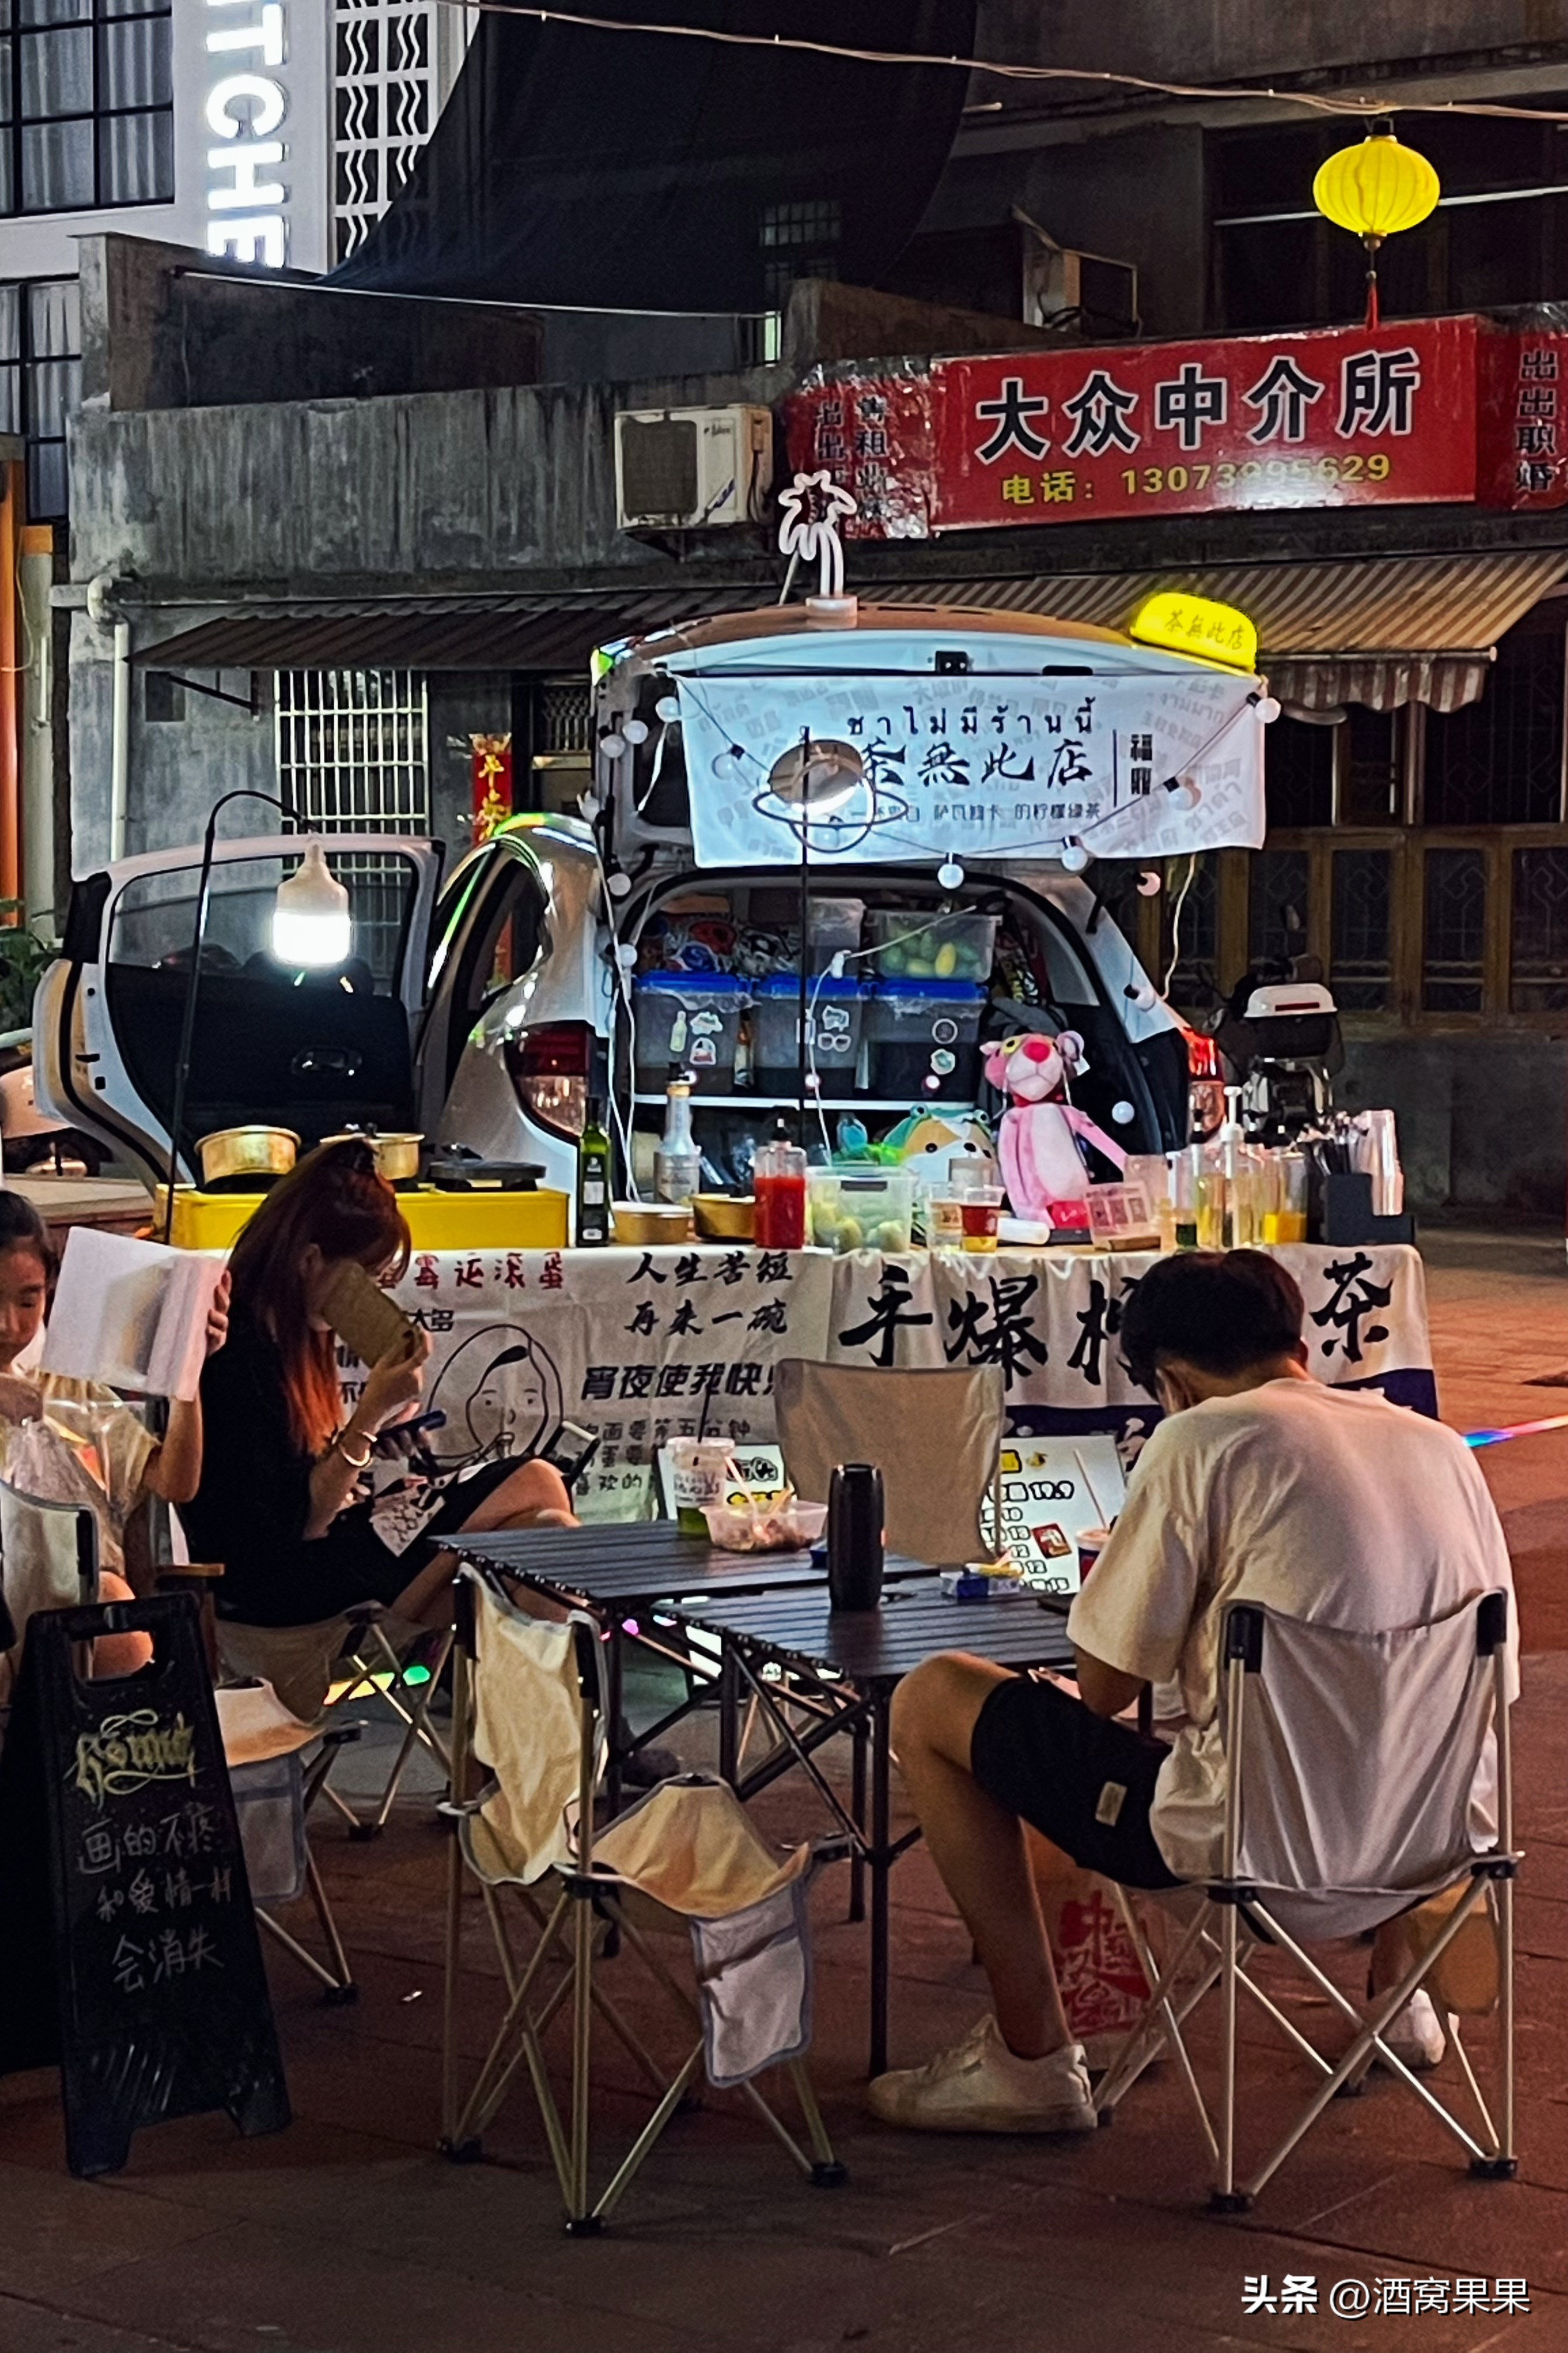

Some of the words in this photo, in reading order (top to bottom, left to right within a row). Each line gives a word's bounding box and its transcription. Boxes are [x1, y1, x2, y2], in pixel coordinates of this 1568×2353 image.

[975, 349, 1419, 463] 大众中介所
[626, 1250, 794, 1288] 人生苦短
[581, 1362, 775, 1400] 宵夜使我快
